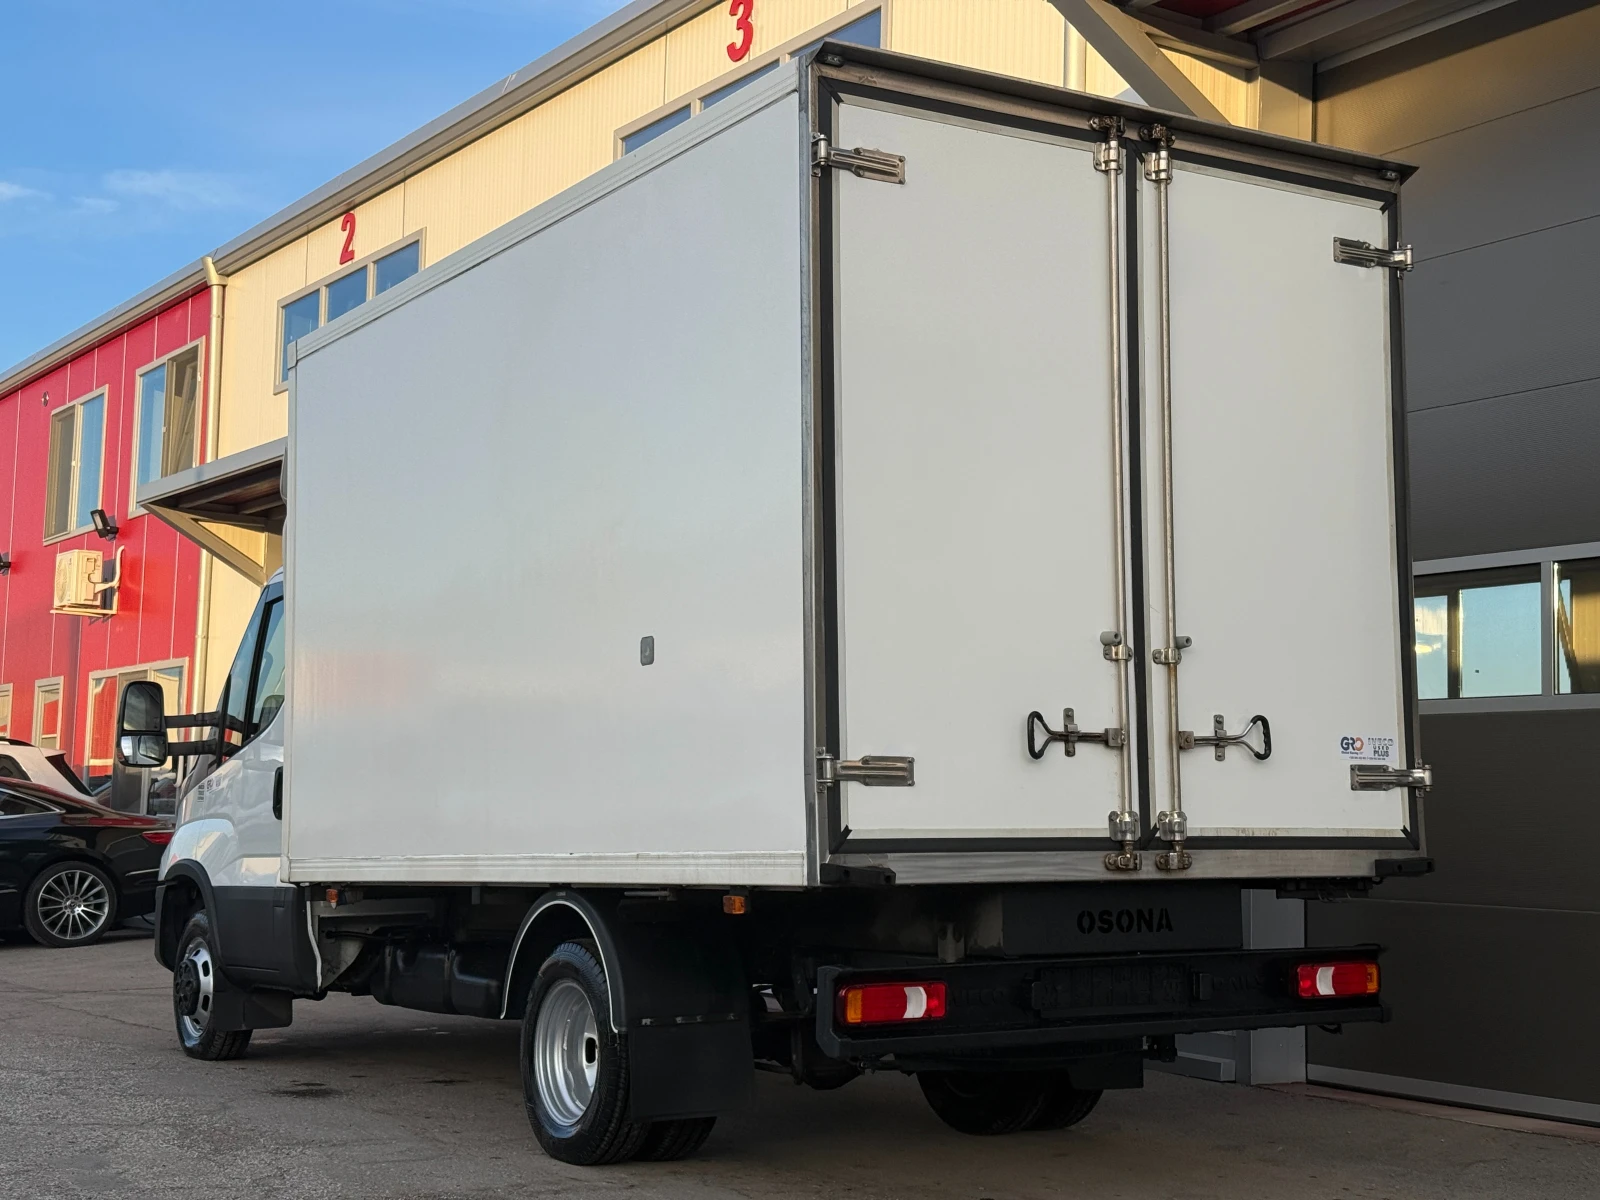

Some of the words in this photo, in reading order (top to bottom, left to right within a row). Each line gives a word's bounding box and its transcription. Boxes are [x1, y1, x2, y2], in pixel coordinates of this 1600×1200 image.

[727, 0, 754, 62] 3
[339, 212, 356, 265] 2
[1340, 736, 1364, 751] GRO
[1373, 750, 1390, 758] PLUS
[1077, 908, 1173, 934] OSONA
